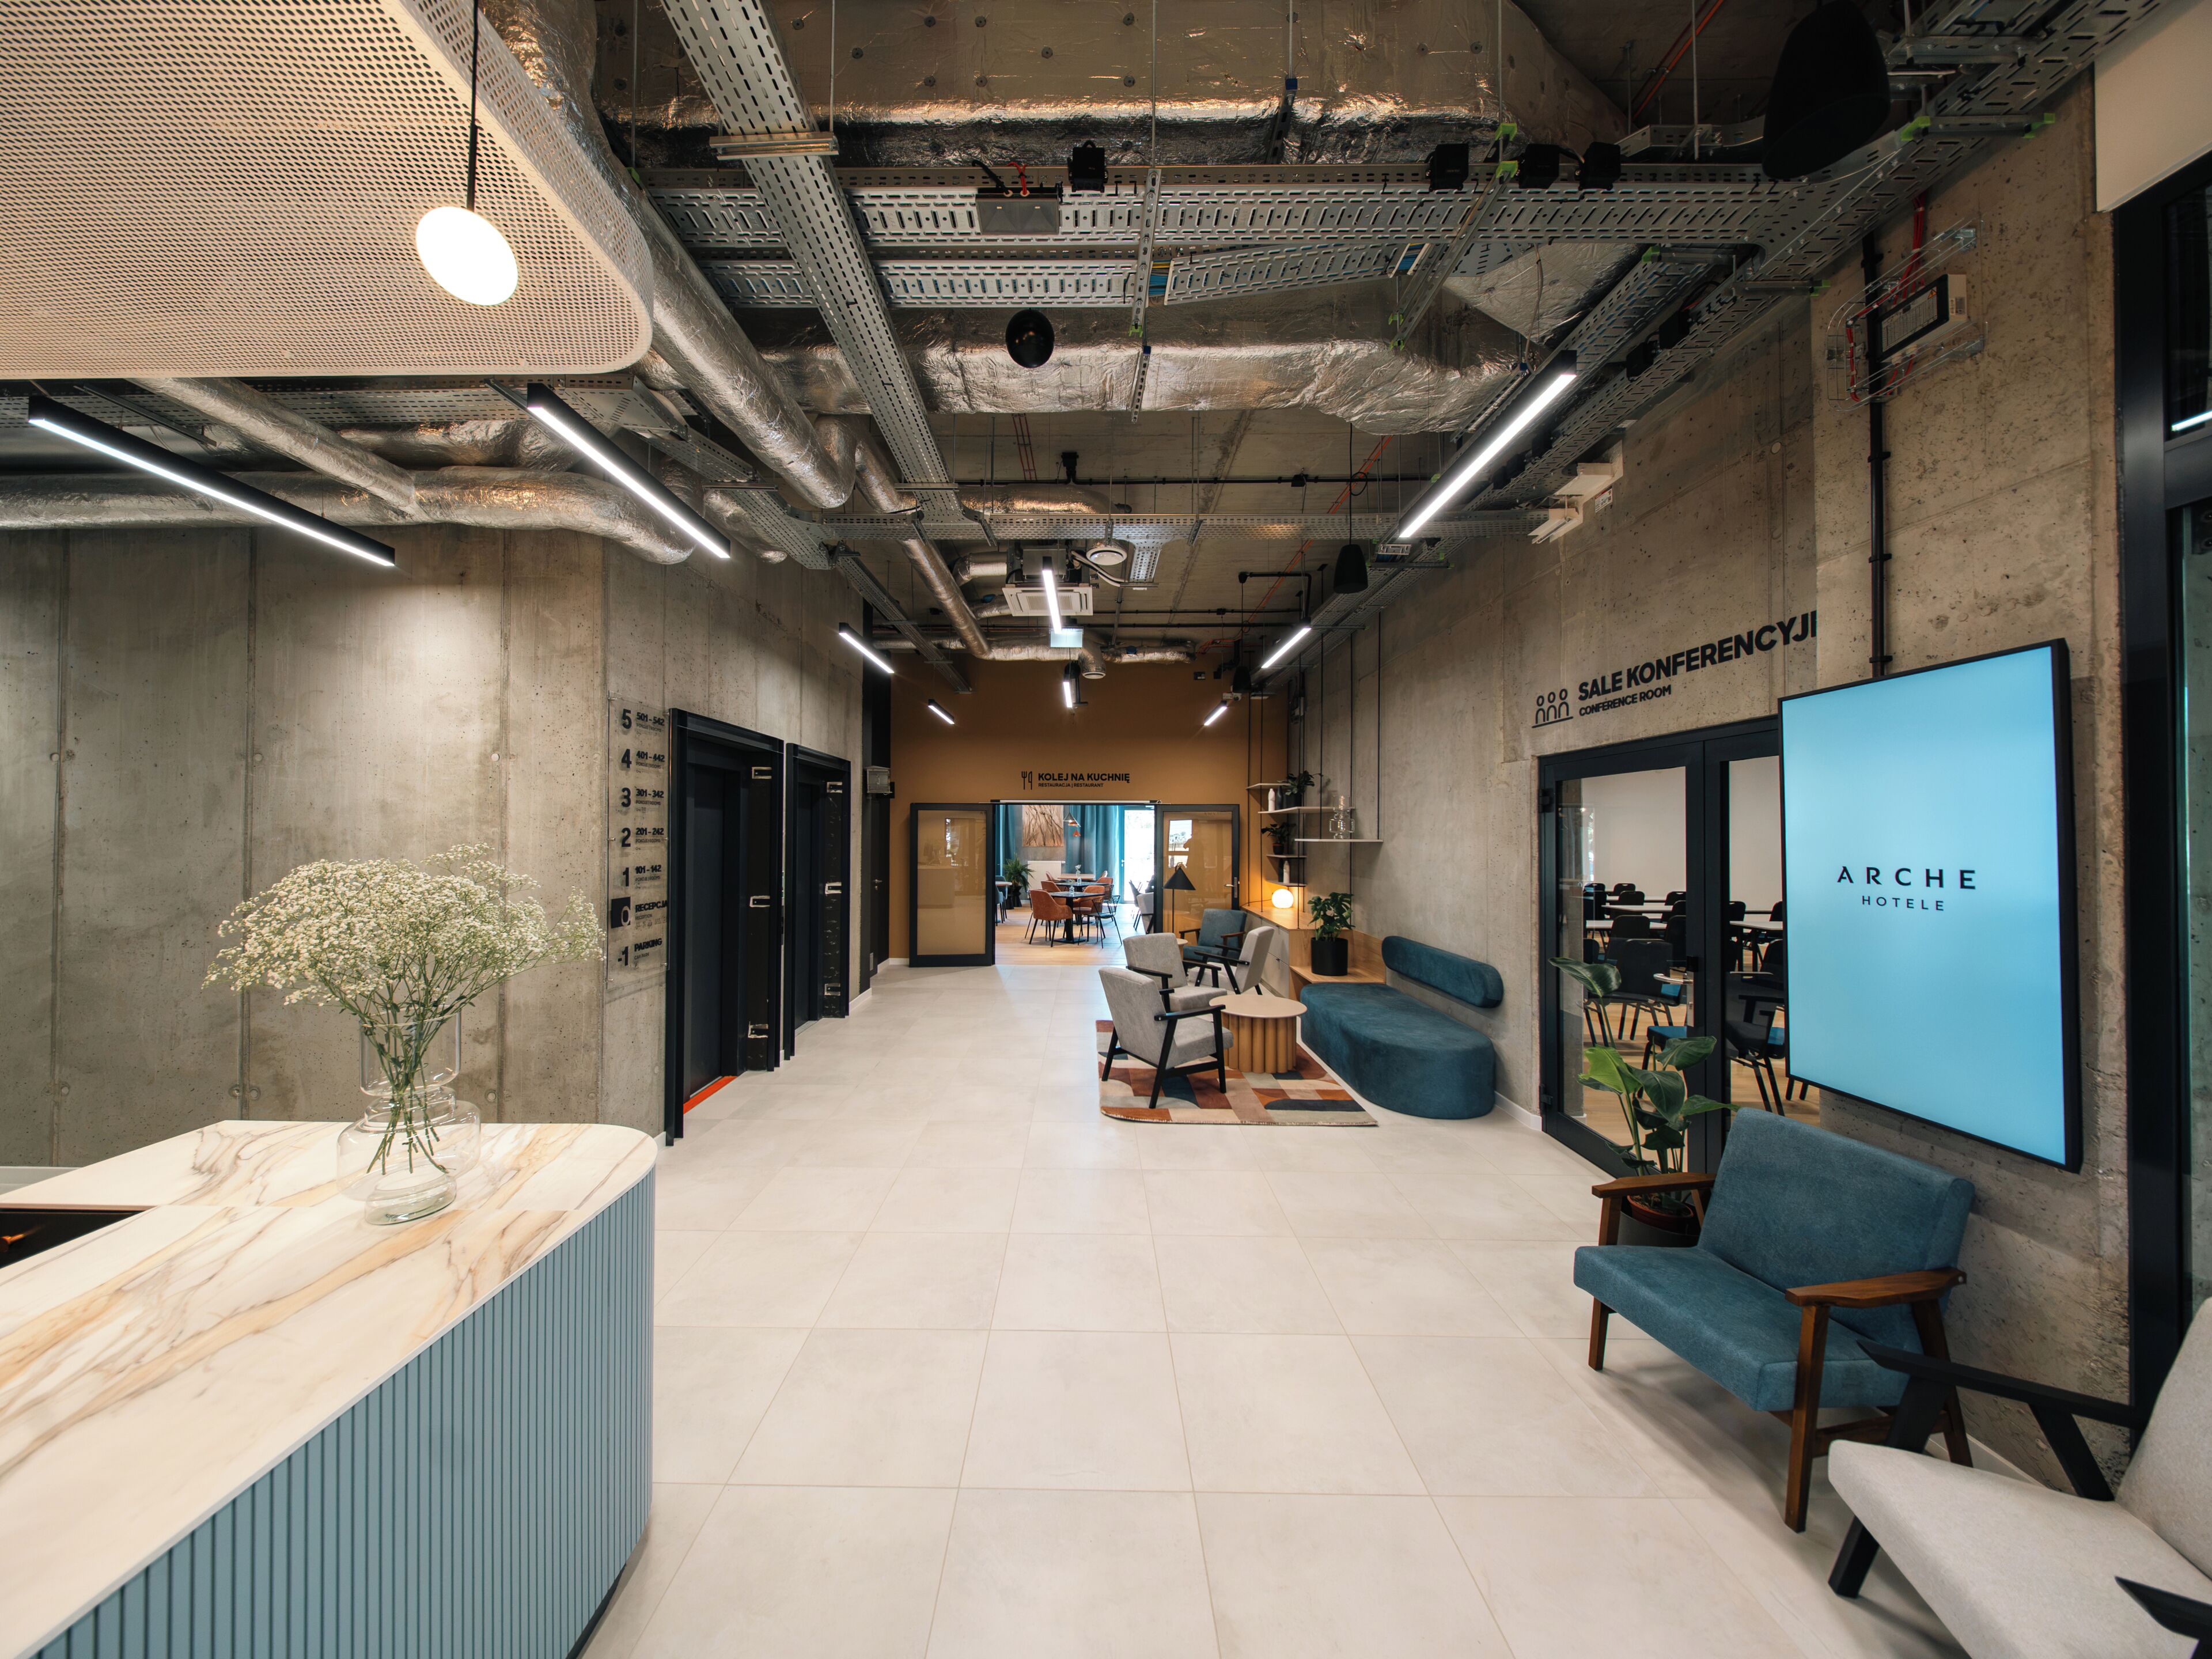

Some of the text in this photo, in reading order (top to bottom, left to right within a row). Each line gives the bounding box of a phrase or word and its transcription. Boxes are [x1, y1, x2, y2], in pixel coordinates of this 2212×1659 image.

[1578, 670, 1623, 701] SALE
[1579, 684, 1672, 717] CONFERENCE ROOM
[622, 709, 632, 729] 5
[621, 748, 632, 768] 4
[1038, 773, 1130, 783] KOLEJ NA KUCHNIĘ
[621, 787, 631, 807] 3
[621, 827, 631, 847] 2
[623, 867, 629, 887] 1
[1837, 866, 1976, 889] ARCHE
[635, 900, 668, 913] RECEPCJA
[1862, 896, 1944, 911] HOTELE
[621, 906, 630, 927] 0
[634, 938, 662, 952] PARKING
[618, 946, 628, 966] -1
